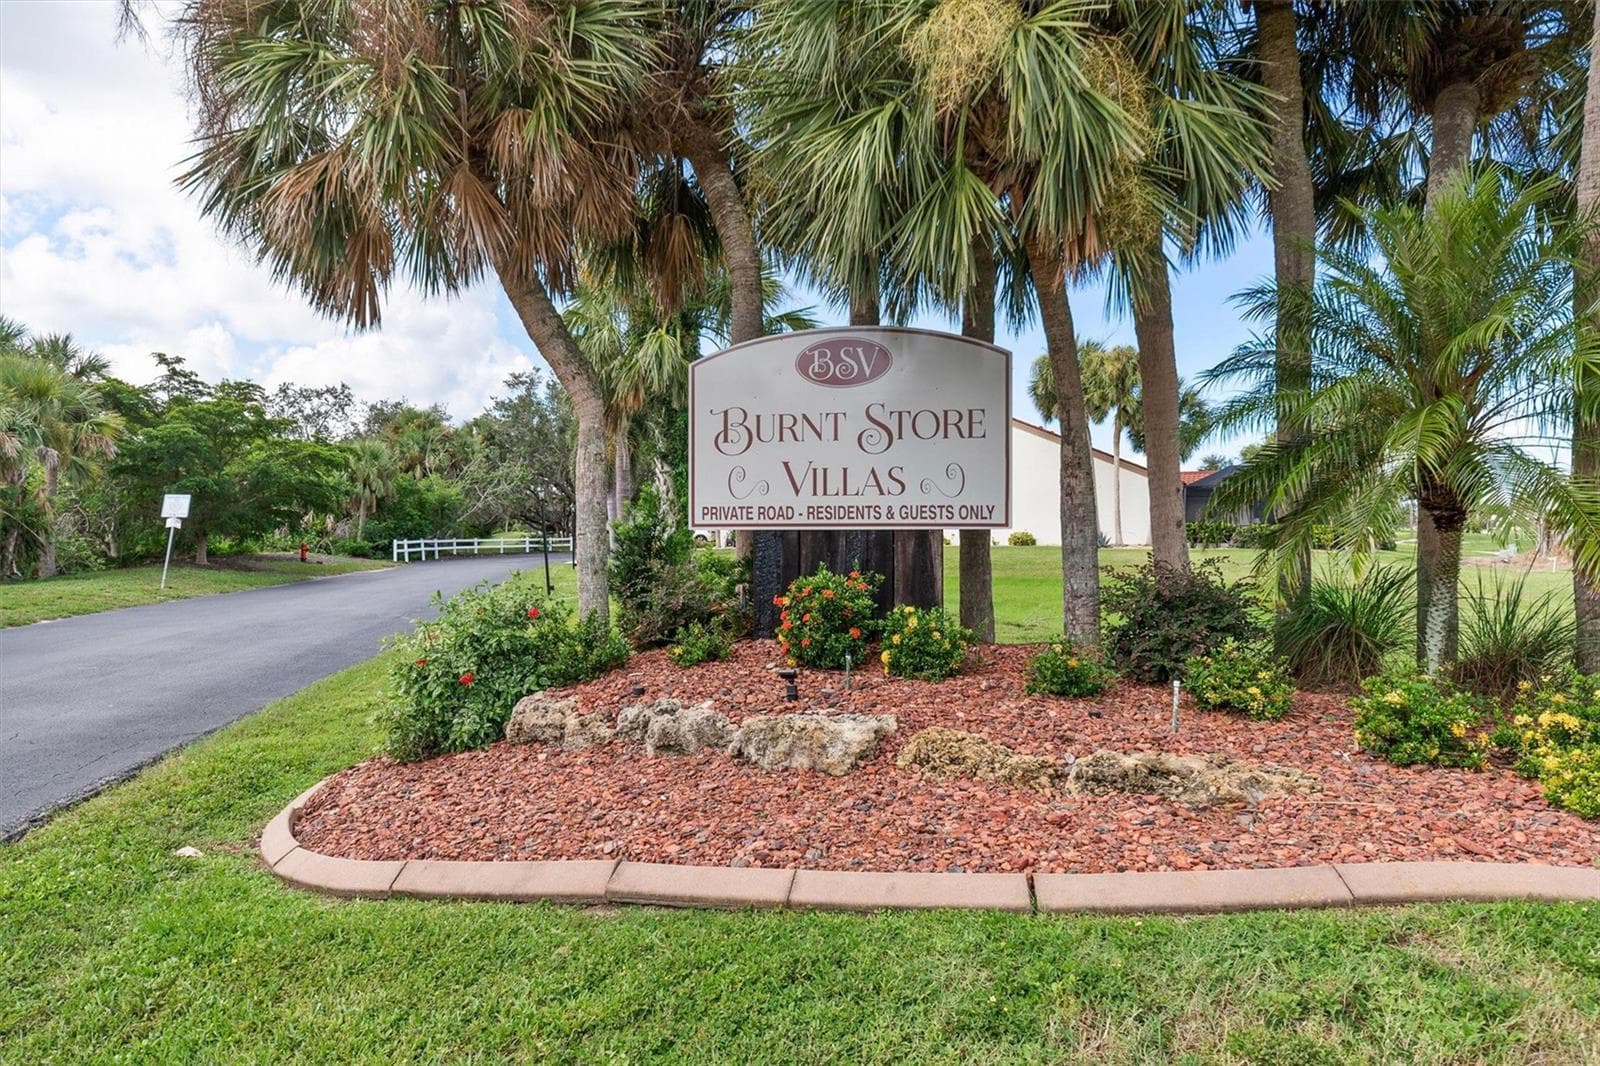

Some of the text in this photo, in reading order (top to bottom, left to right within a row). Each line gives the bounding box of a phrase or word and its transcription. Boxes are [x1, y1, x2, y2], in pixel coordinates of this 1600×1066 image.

[806, 347, 881, 381] BSV
[702, 506, 753, 521] PRIVATE
[757, 506, 794, 520] ROAD
[807, 505, 882, 520] RESIDENTS
[886, 505, 895, 520] &
[899, 505, 954, 520] GUESTS
[959, 505, 995, 520] ONLY
